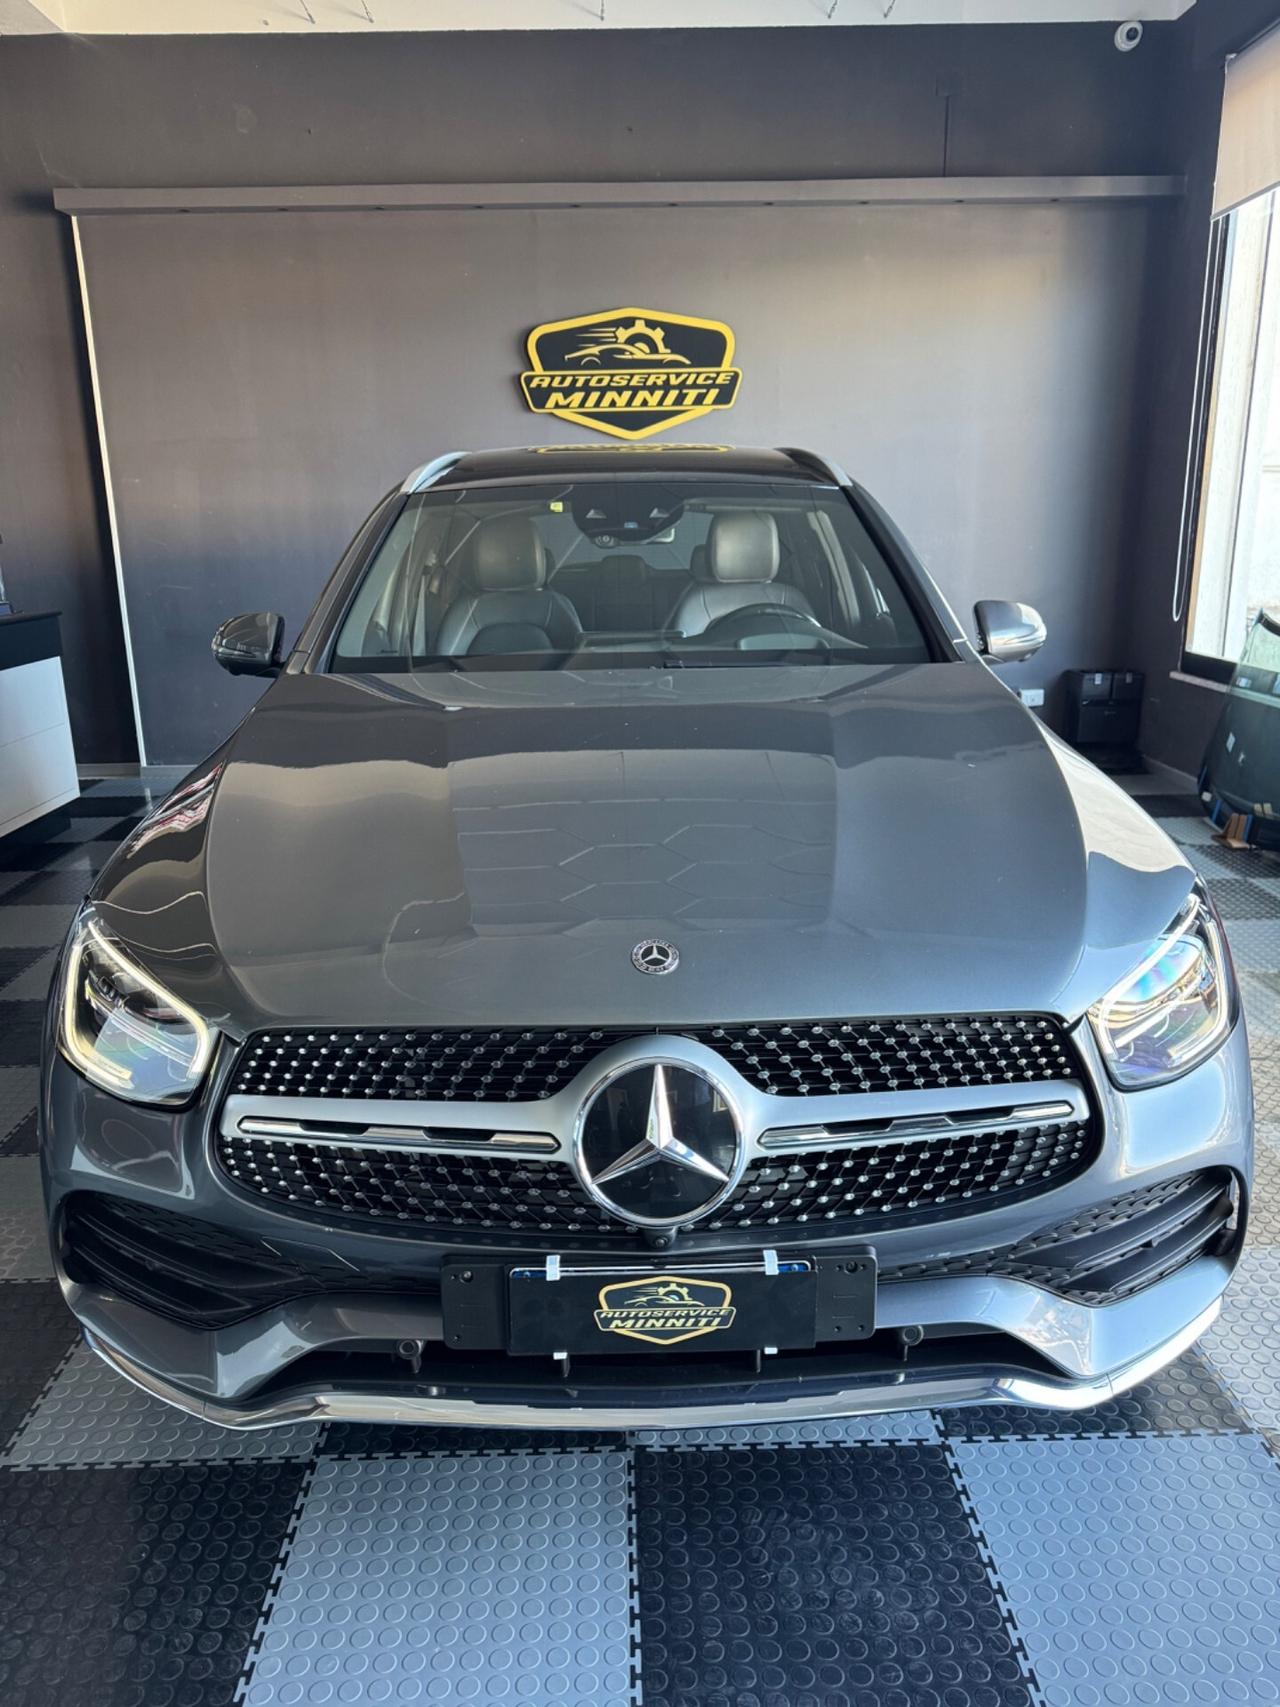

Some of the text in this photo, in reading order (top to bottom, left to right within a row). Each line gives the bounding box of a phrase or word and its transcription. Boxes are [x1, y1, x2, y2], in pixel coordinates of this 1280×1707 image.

[529, 372, 735, 388] AUTOSERVICE
[544, 388, 720, 409] MINNITI
[600, 1309, 731, 1318] AUTOSERVICE
[609, 1317, 722, 1329] MINNITI
